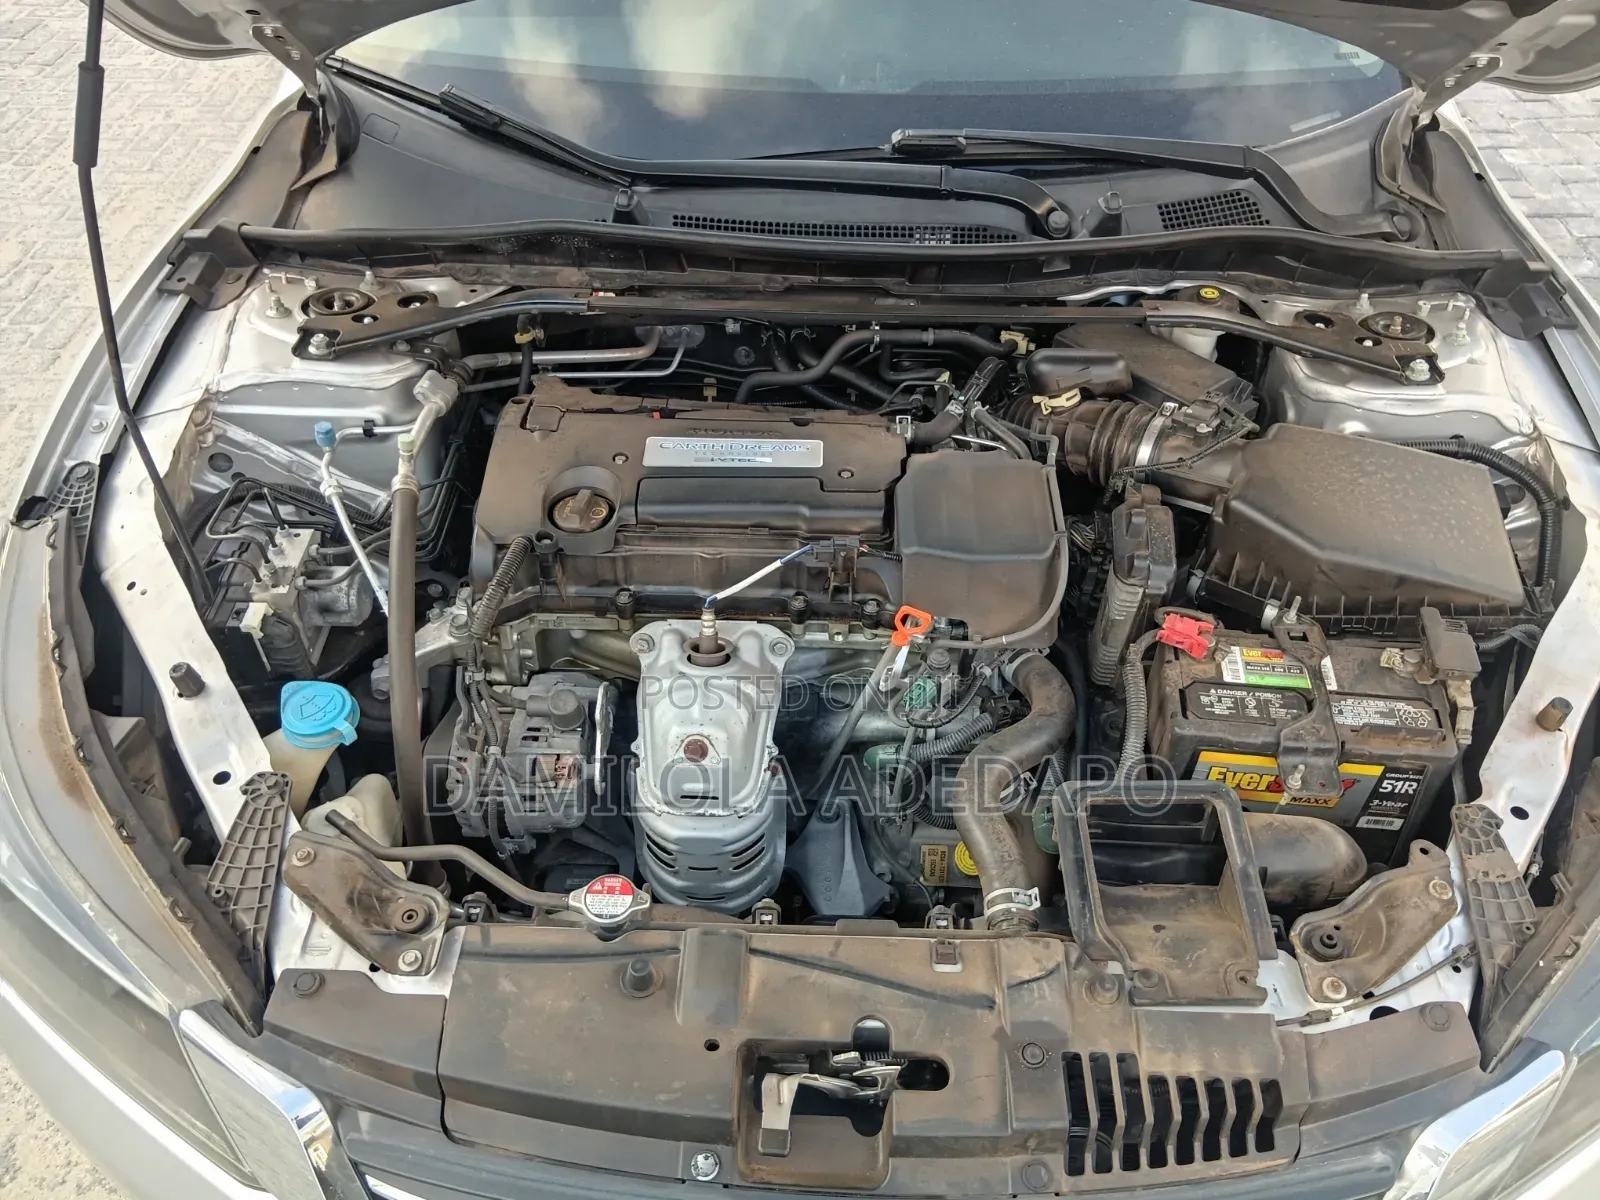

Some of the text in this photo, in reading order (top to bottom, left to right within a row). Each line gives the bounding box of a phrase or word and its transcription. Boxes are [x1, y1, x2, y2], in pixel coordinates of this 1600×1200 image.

[659, 441, 810, 452] EARTH DREAMS
[1217, 688, 1247, 696] DANGER
[1255, 691, 1282, 699] POISON
[1378, 779, 1418, 795] 51R
[1289, 795, 1332, 806] MAXX
[1369, 799, 1409, 808] 3-Year
